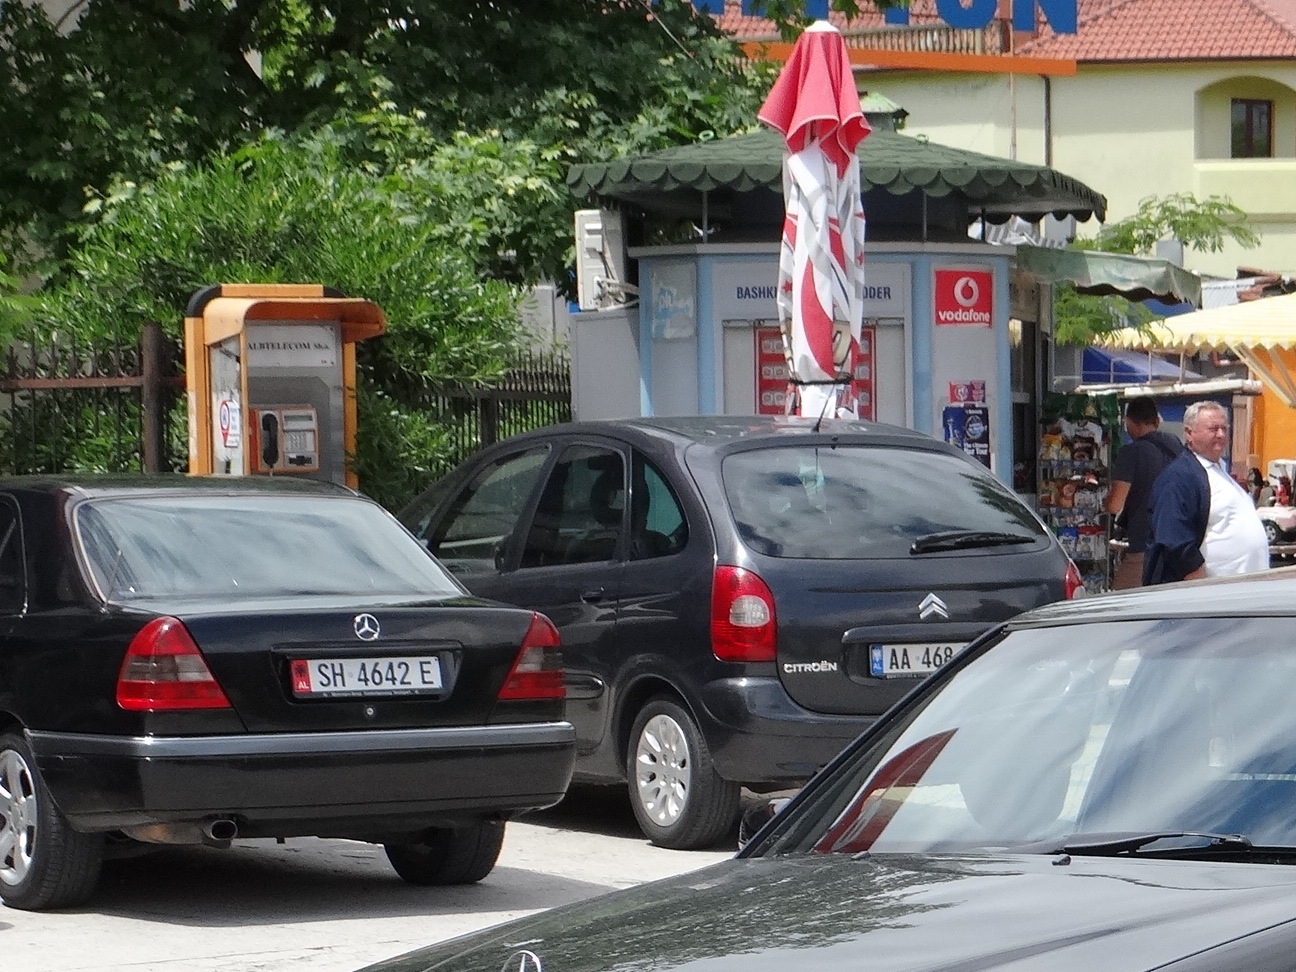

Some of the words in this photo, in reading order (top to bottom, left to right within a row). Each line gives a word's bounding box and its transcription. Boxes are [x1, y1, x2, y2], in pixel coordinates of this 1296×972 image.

[736, 285, 778, 299] BASHKI
[938, 308, 990, 322] vodafone
[889, 647, 911, 670] AA
[317, 662, 346, 688] SH
[357, 660, 412, 687] 4642
[418, 660, 434, 685] E
[783, 660, 838, 674] CITROËN
[298, 680, 310, 690] AL
